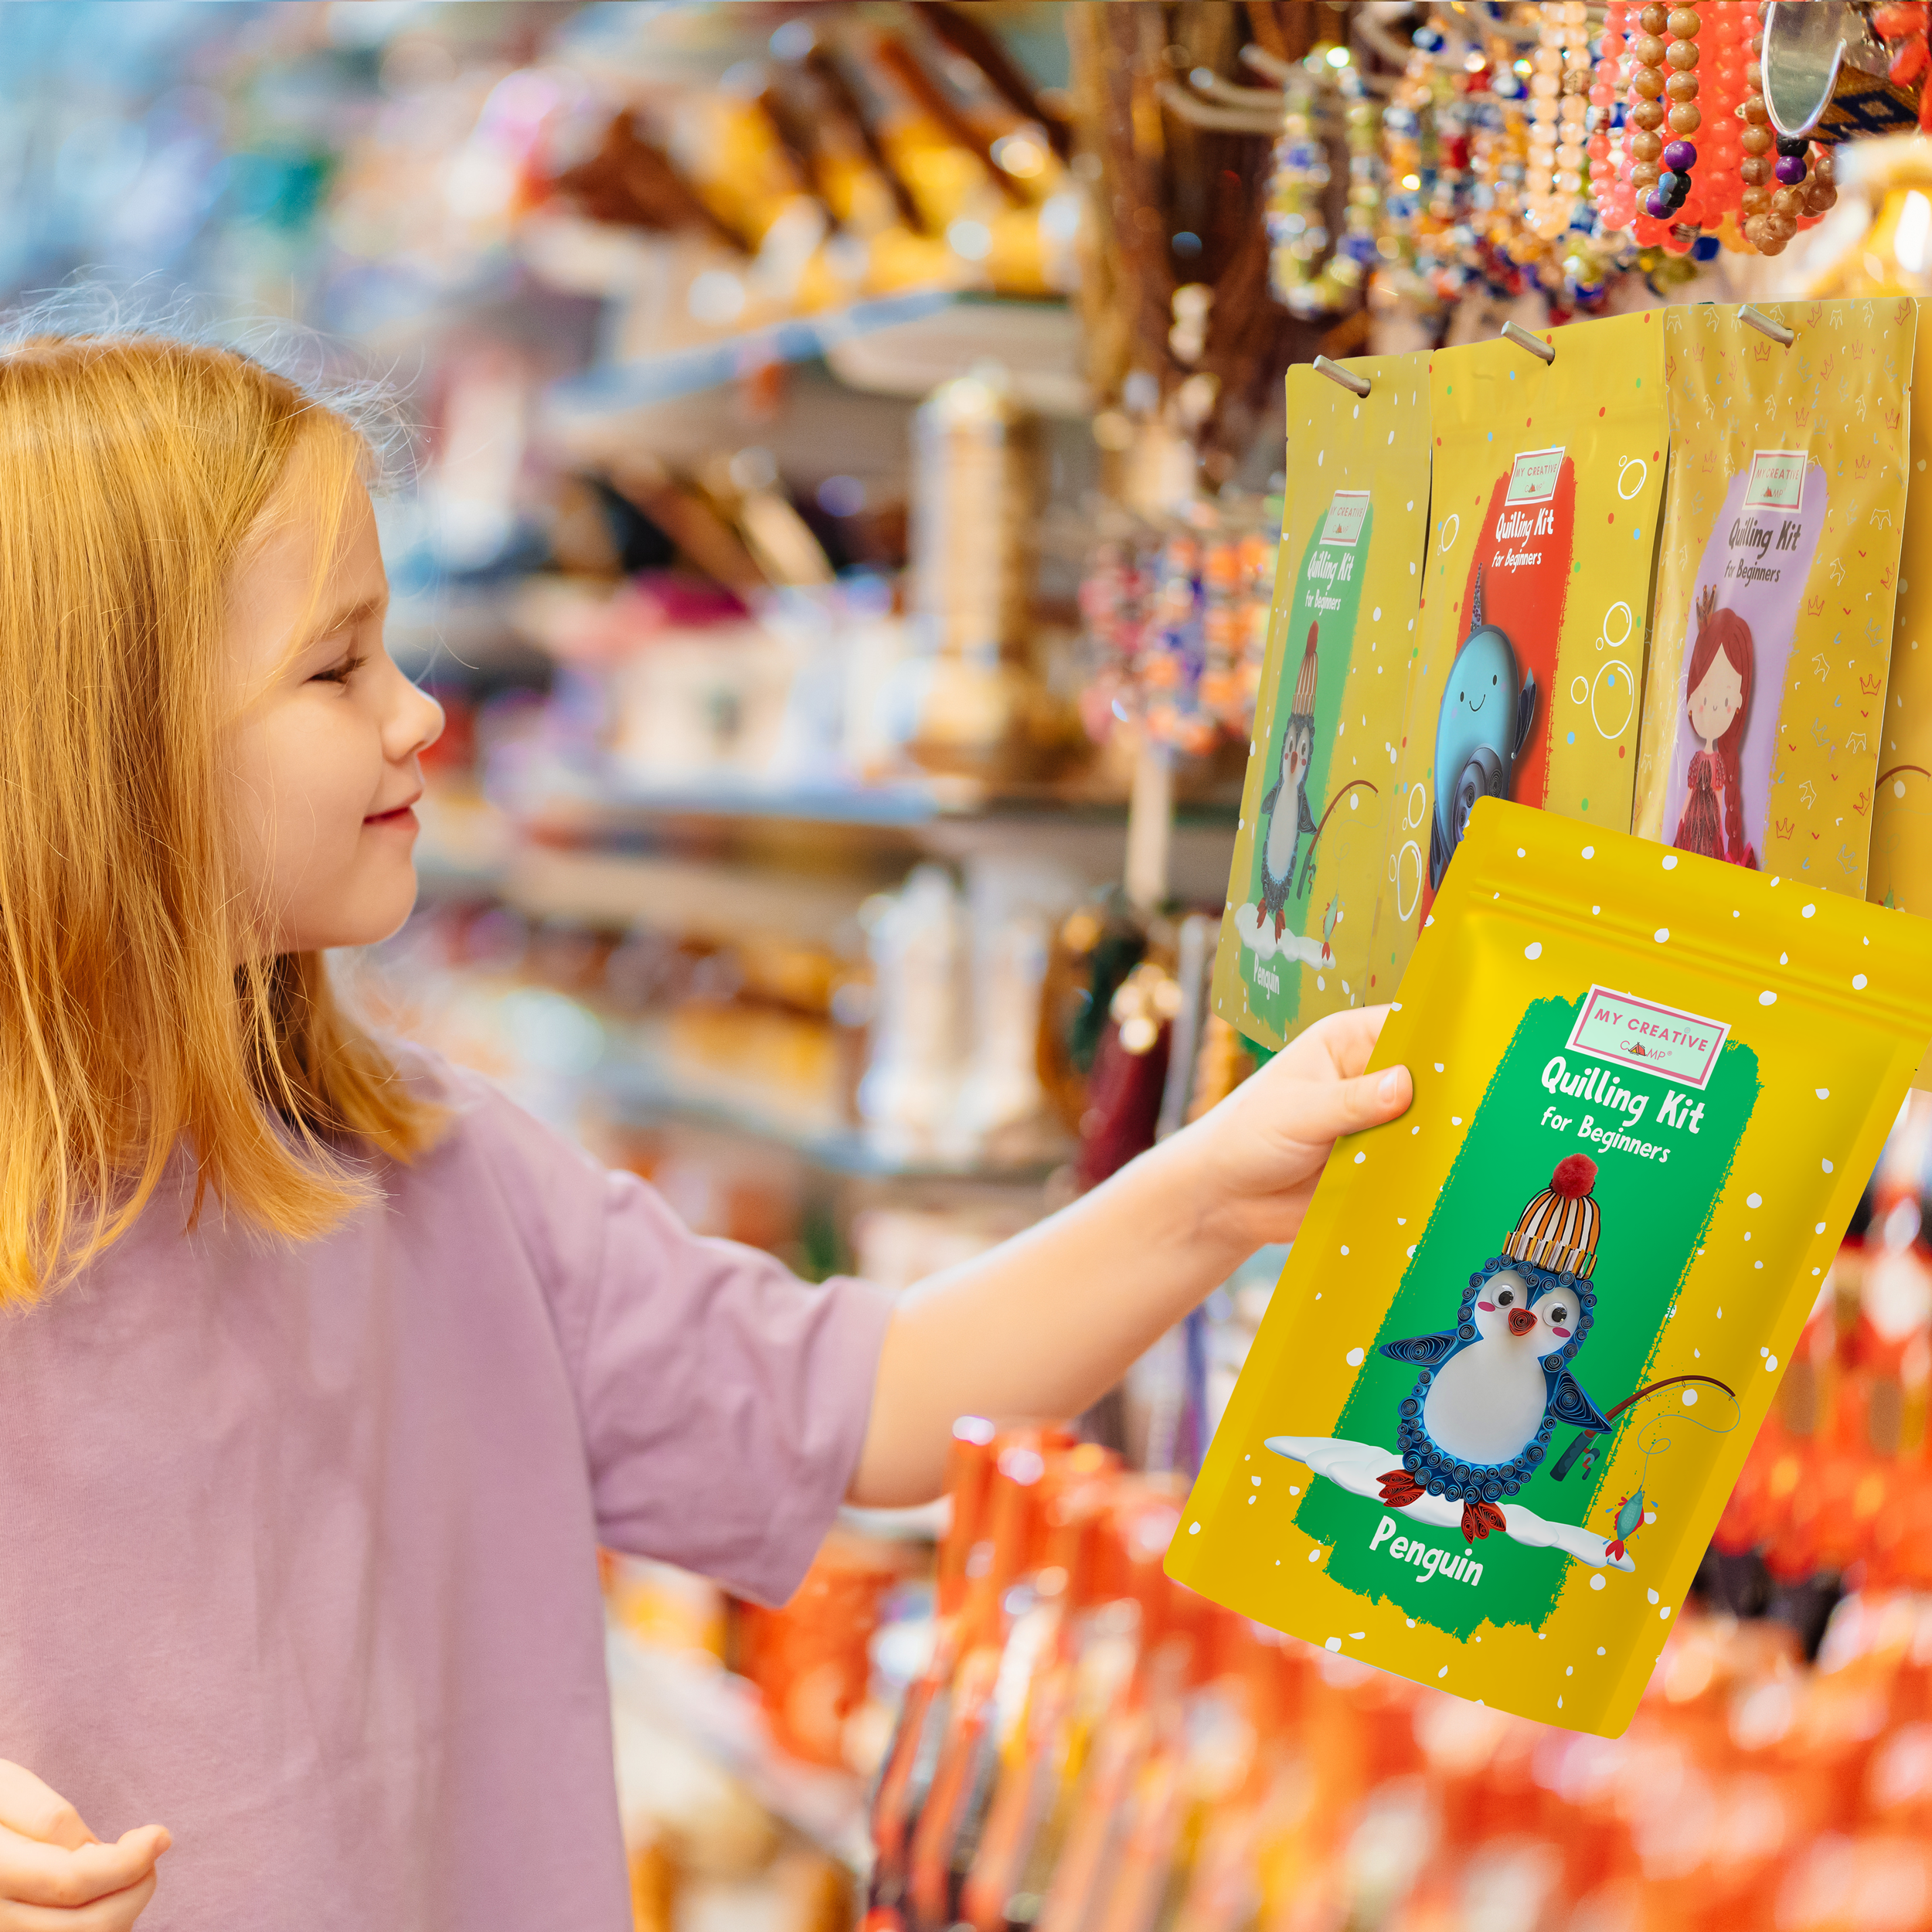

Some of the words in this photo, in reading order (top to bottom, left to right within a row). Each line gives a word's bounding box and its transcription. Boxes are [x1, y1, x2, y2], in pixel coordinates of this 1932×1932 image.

[1527, 464, 1557, 477] CREATIVE
[1755, 468, 1766, 479] MY
[1766, 468, 1799, 480] CREATIVE
[1337, 507, 1363, 517] CREATIVE
[1495, 511, 1534, 547] Quilling
[1533, 508, 1554, 536] Kit
[1728, 517, 1774, 560] Quilling
[1775, 520, 1801, 551] Kit
[1307, 550, 1338, 590] Quilling
[1337, 553, 1355, 581] Kit
[1492, 551, 1505, 567] for
[1505, 548, 1542, 573] Beginners
[1724, 560, 1736, 578] for
[1736, 558, 1781, 587] Beginners
[1305, 590, 1314, 607] for
[1314, 589, 1342, 616] Beginners
[1253, 952, 1280, 1000] Penguin
[1594, 1009, 1623, 1026] MY
[1628, 1018, 1709, 1053] CREATIVE
[1541, 1056, 1650, 1127] Quilling
[1656, 1089, 1706, 1134] Kit
[1541, 1106, 1573, 1131] for
[1577, 1114, 1671, 1163] Beginners
[1369, 1515, 1484, 1587] Penguin
